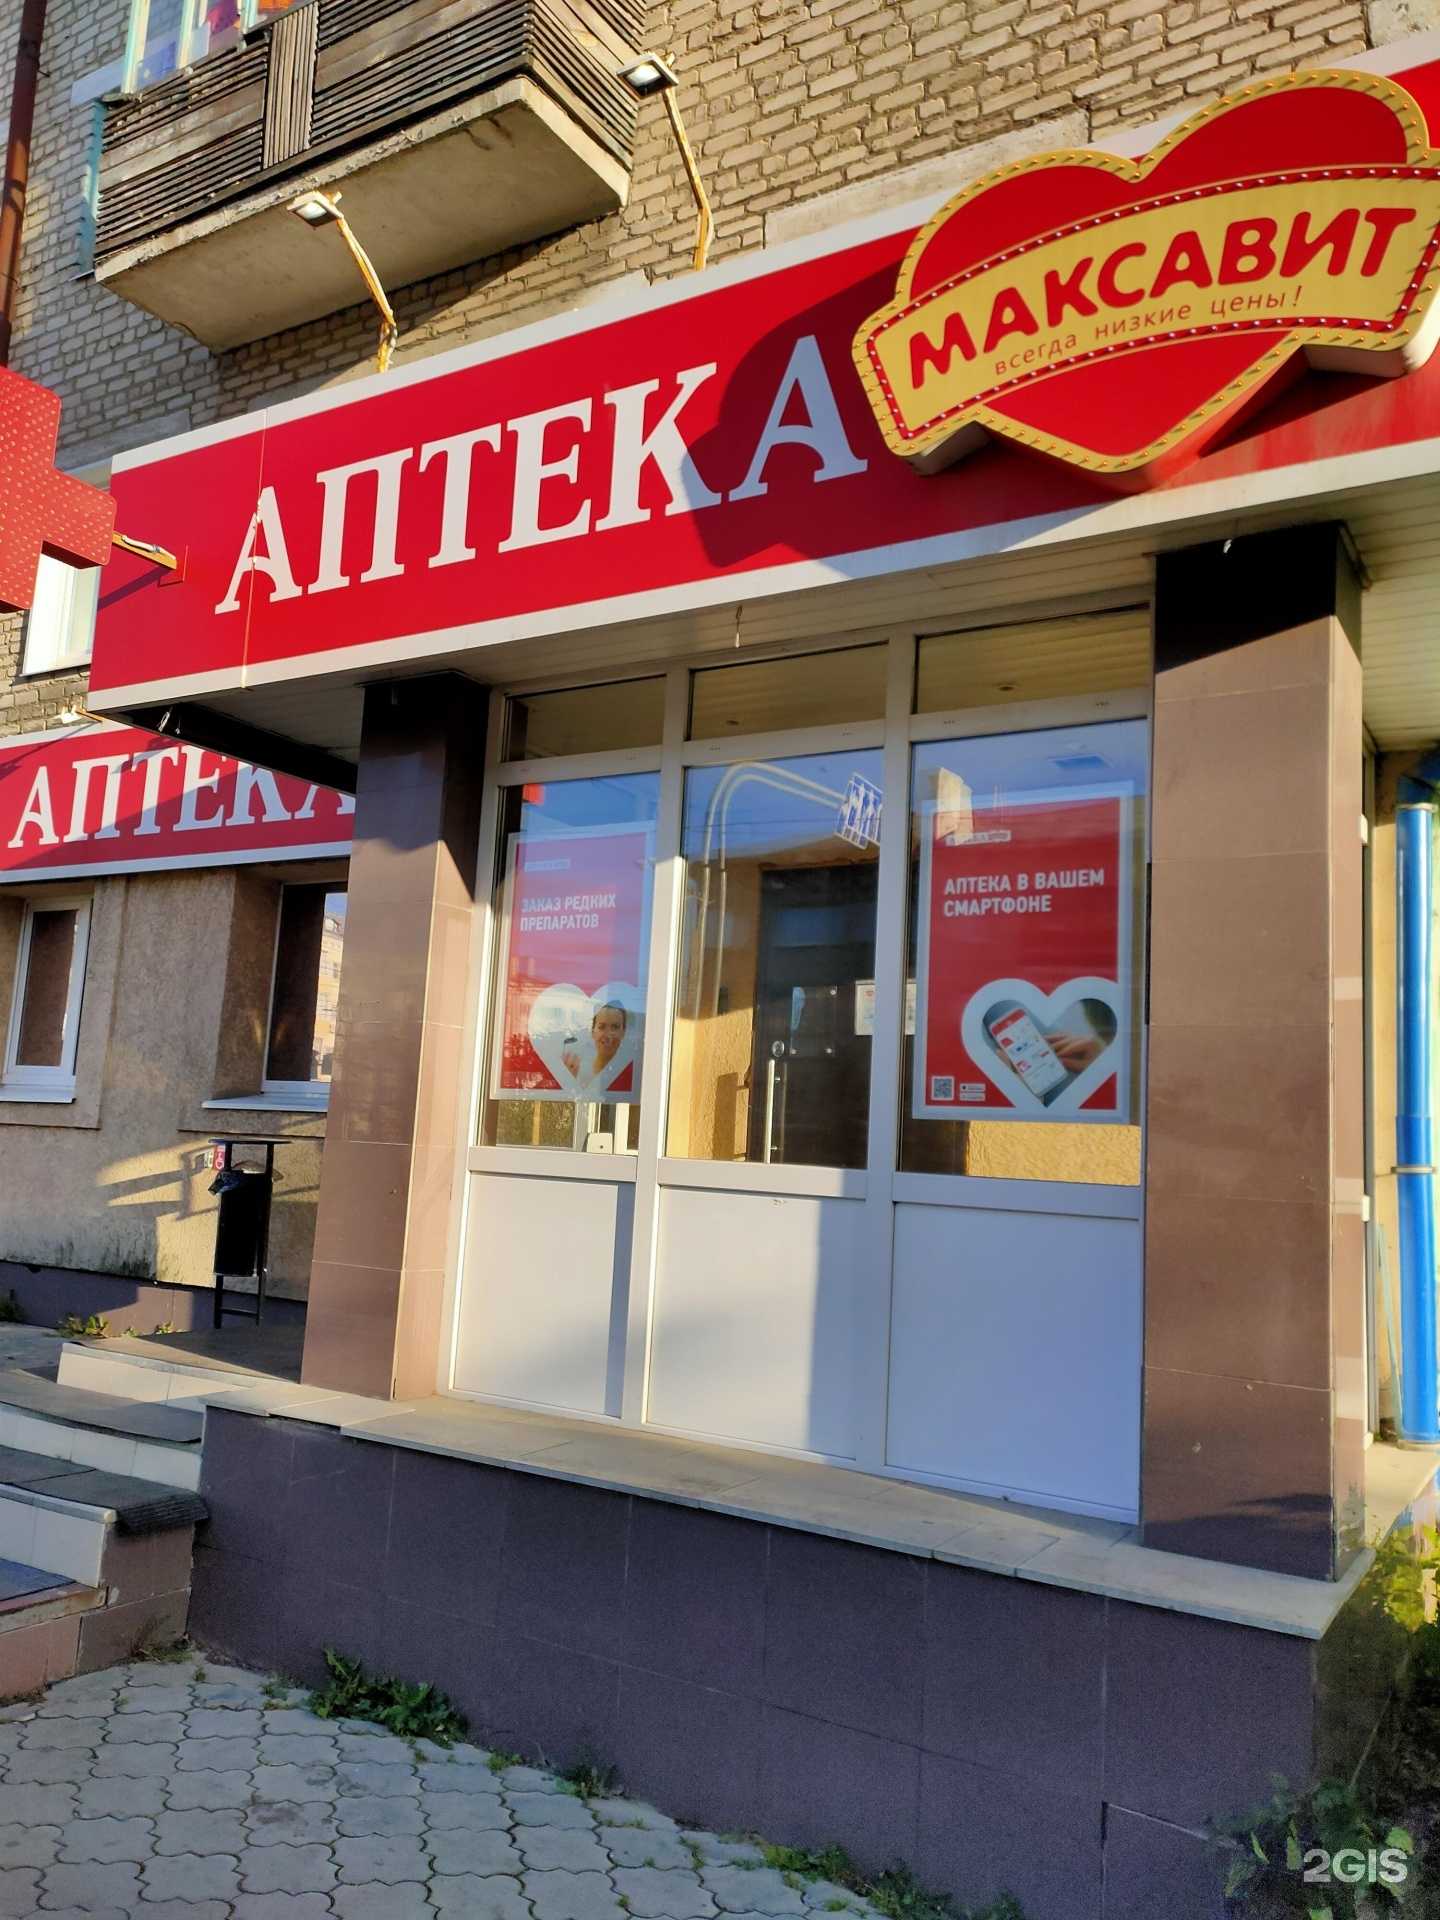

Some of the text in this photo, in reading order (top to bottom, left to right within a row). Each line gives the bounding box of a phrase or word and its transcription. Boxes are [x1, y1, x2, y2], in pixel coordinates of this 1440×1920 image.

[908, 207, 1417, 390] МАКСАВИТ
[994, 284, 1303, 376] всегда низкие цены!
[214, 333, 868, 615] АПТЕКА
[944, 868, 1105, 895] АПТЕКА В ВАШЕМ
[521, 893, 616, 913] ЗАКАЗ РЕДКИХ
[943, 895, 1052, 917] СМАРТФОНЕ
[520, 913, 600, 932] ПРЕПАРАТОВ
